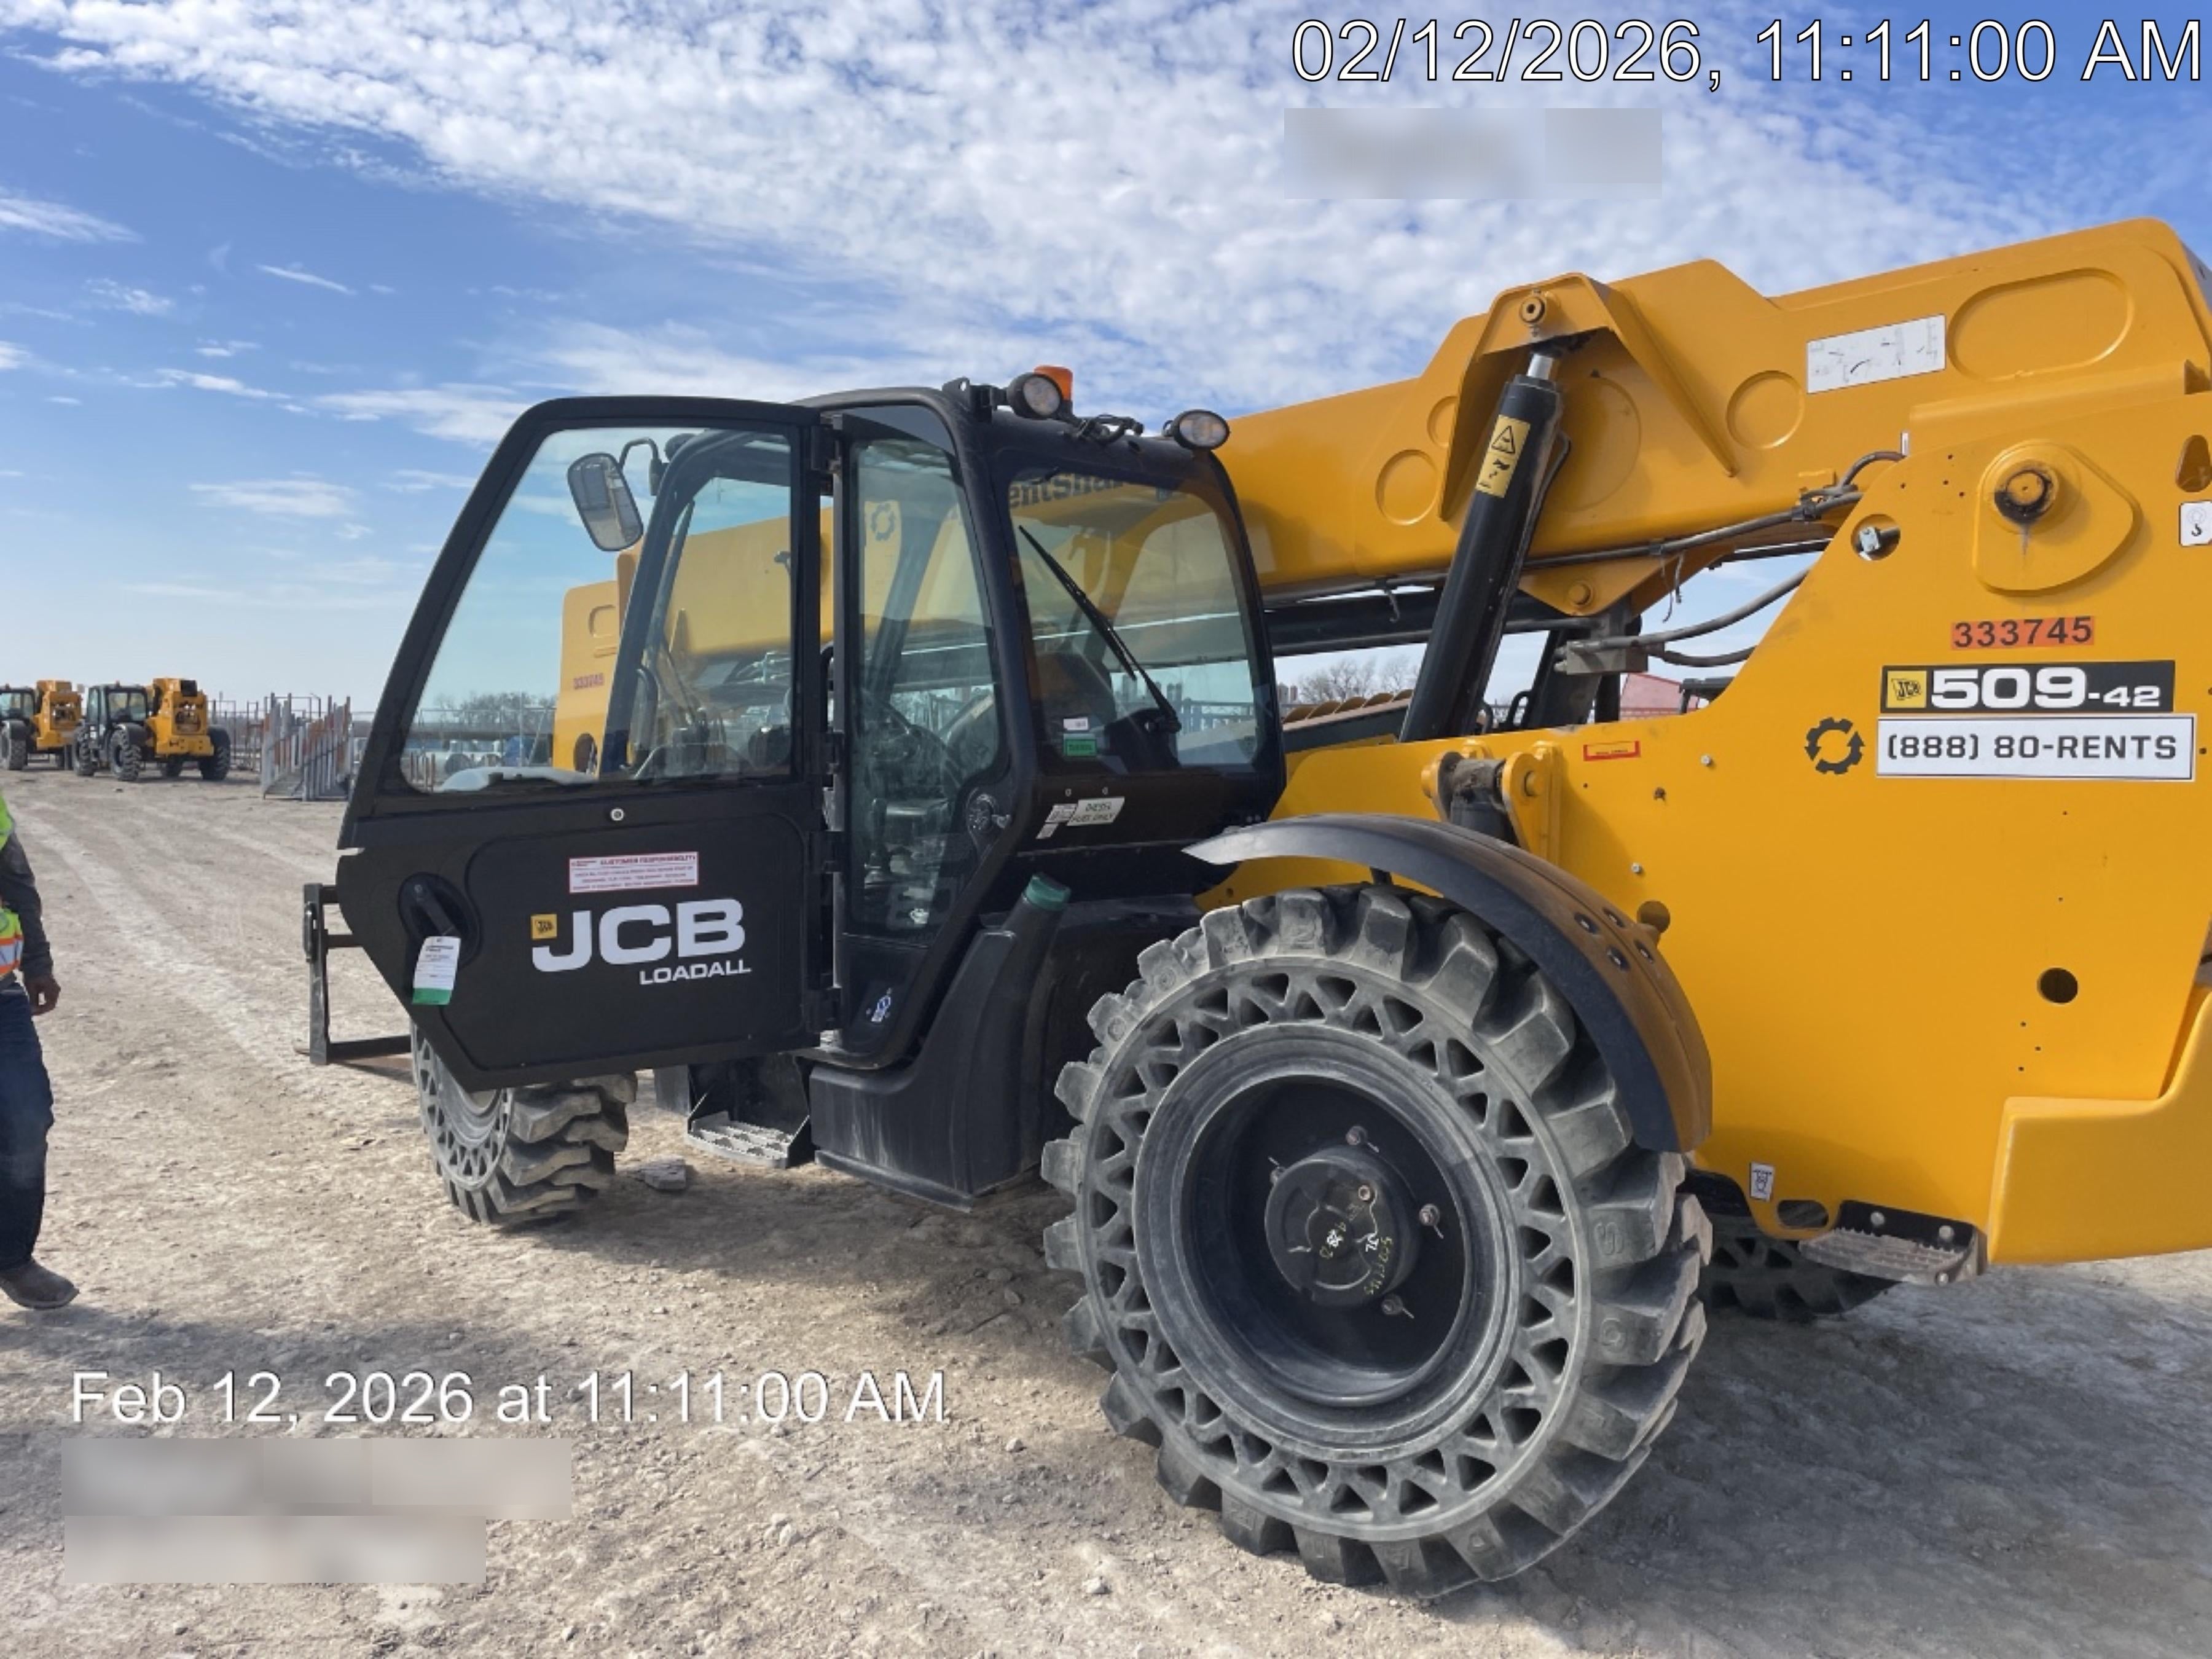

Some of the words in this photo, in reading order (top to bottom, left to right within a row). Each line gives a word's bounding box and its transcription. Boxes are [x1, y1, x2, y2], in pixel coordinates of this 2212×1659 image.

[1954, 616, 2092, 648] 333745
[1931, 667, 2160, 708] 509-42
[1888, 735, 1979, 759] (888)
[1994, 735, 2176, 759] 80-RENTS
[532, 898, 745, 972] JCB
[639, 959, 751, 985] LOADALL
